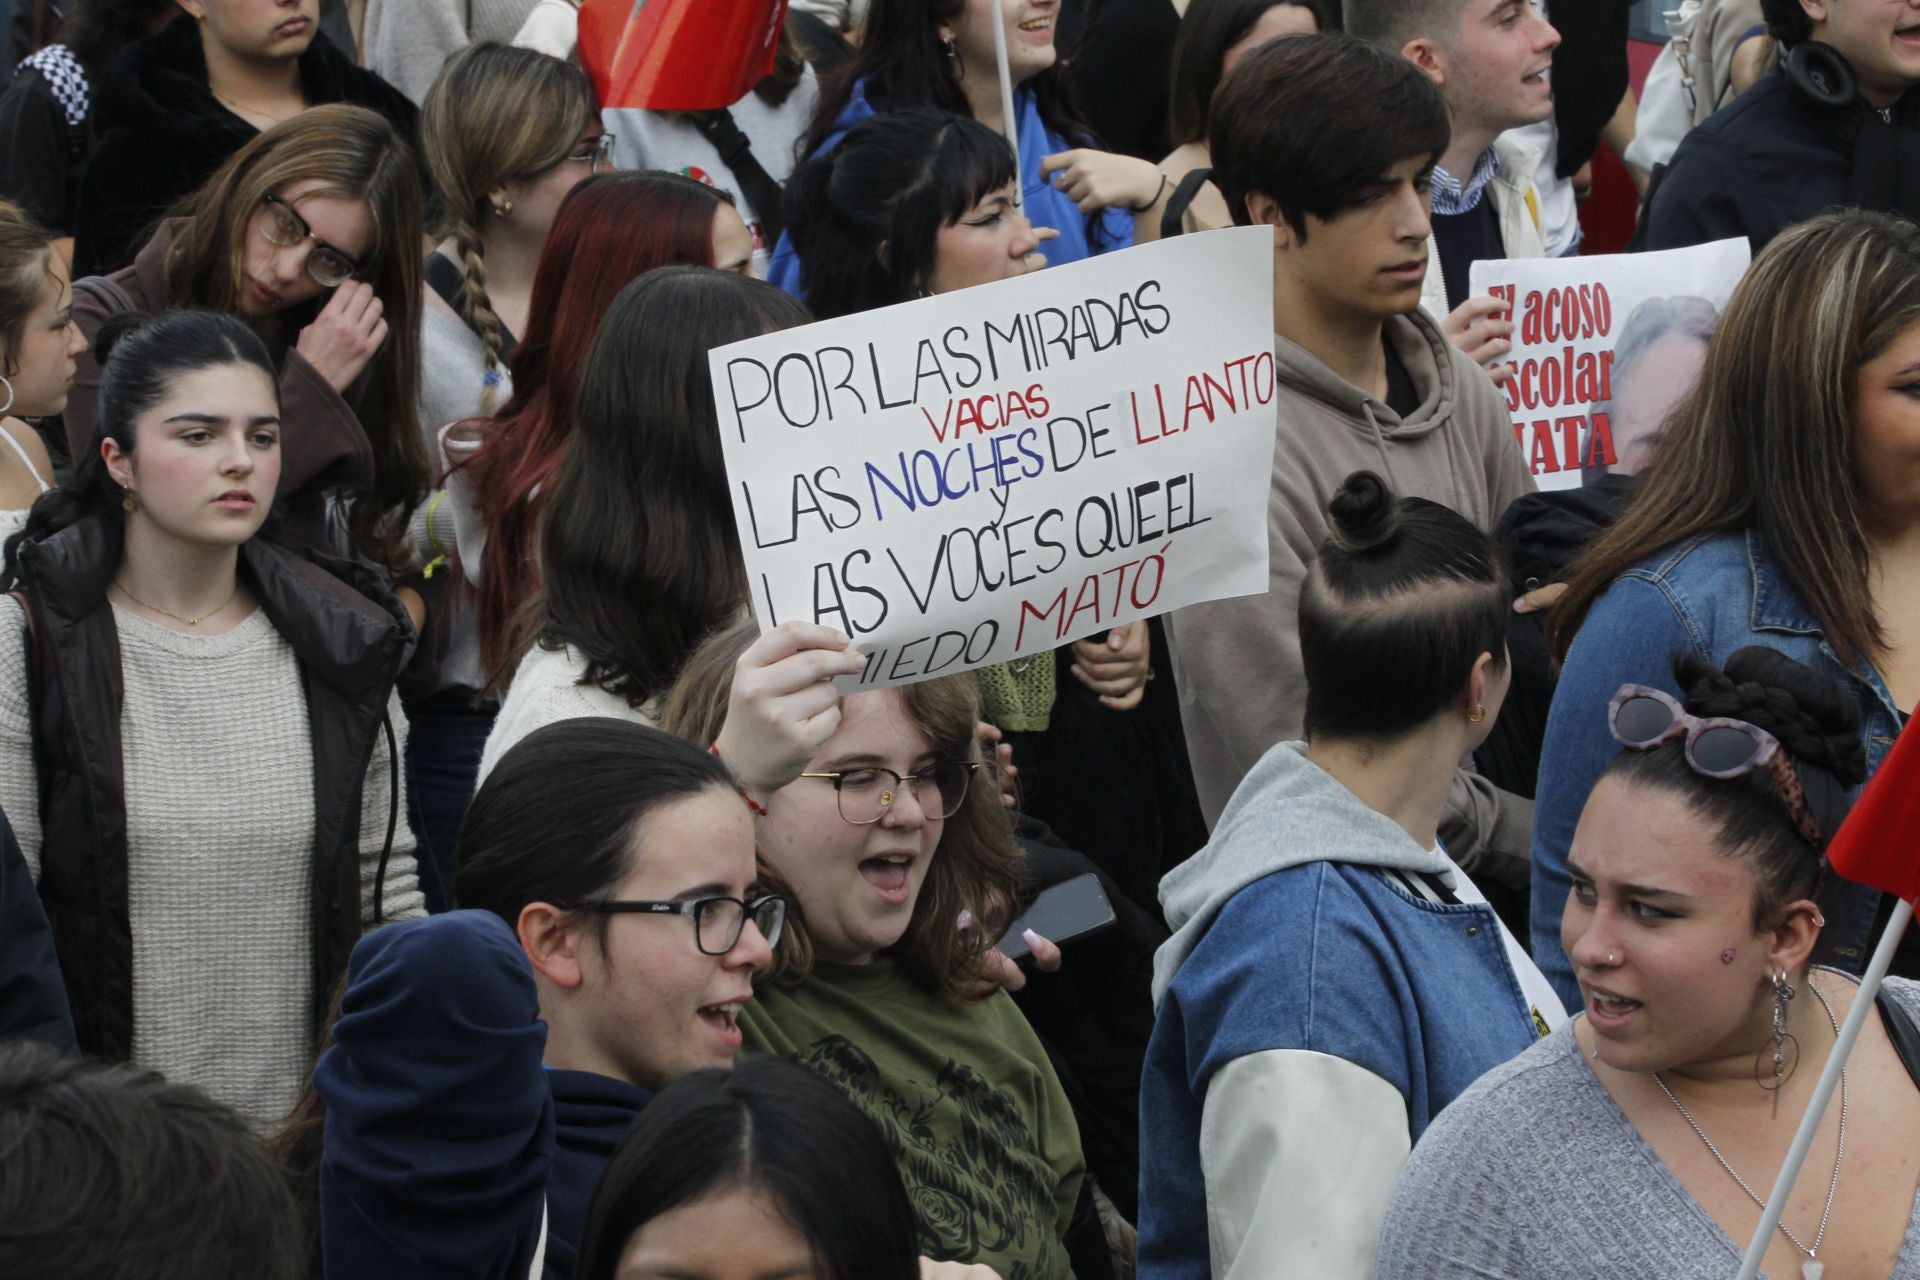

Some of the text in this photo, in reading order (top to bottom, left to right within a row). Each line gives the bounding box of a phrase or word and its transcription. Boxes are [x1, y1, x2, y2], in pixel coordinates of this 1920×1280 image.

[1522, 281, 1612, 346] acoso
[726, 279, 1171, 443] POR LAS MIRADAS
[1490, 346, 1615, 412] scolar
[742, 351, 1275, 548] LAS NOCHES DE LLANTO
[921, 383, 1050, 444] VACIAS
[1513, 412, 1619, 475] ATA
[887, 508, 1067, 614] VOCES
[1076, 480, 1163, 559] QUE
[1167, 473, 1213, 528] EL
[1015, 539, 1173, 652] MATÓ
